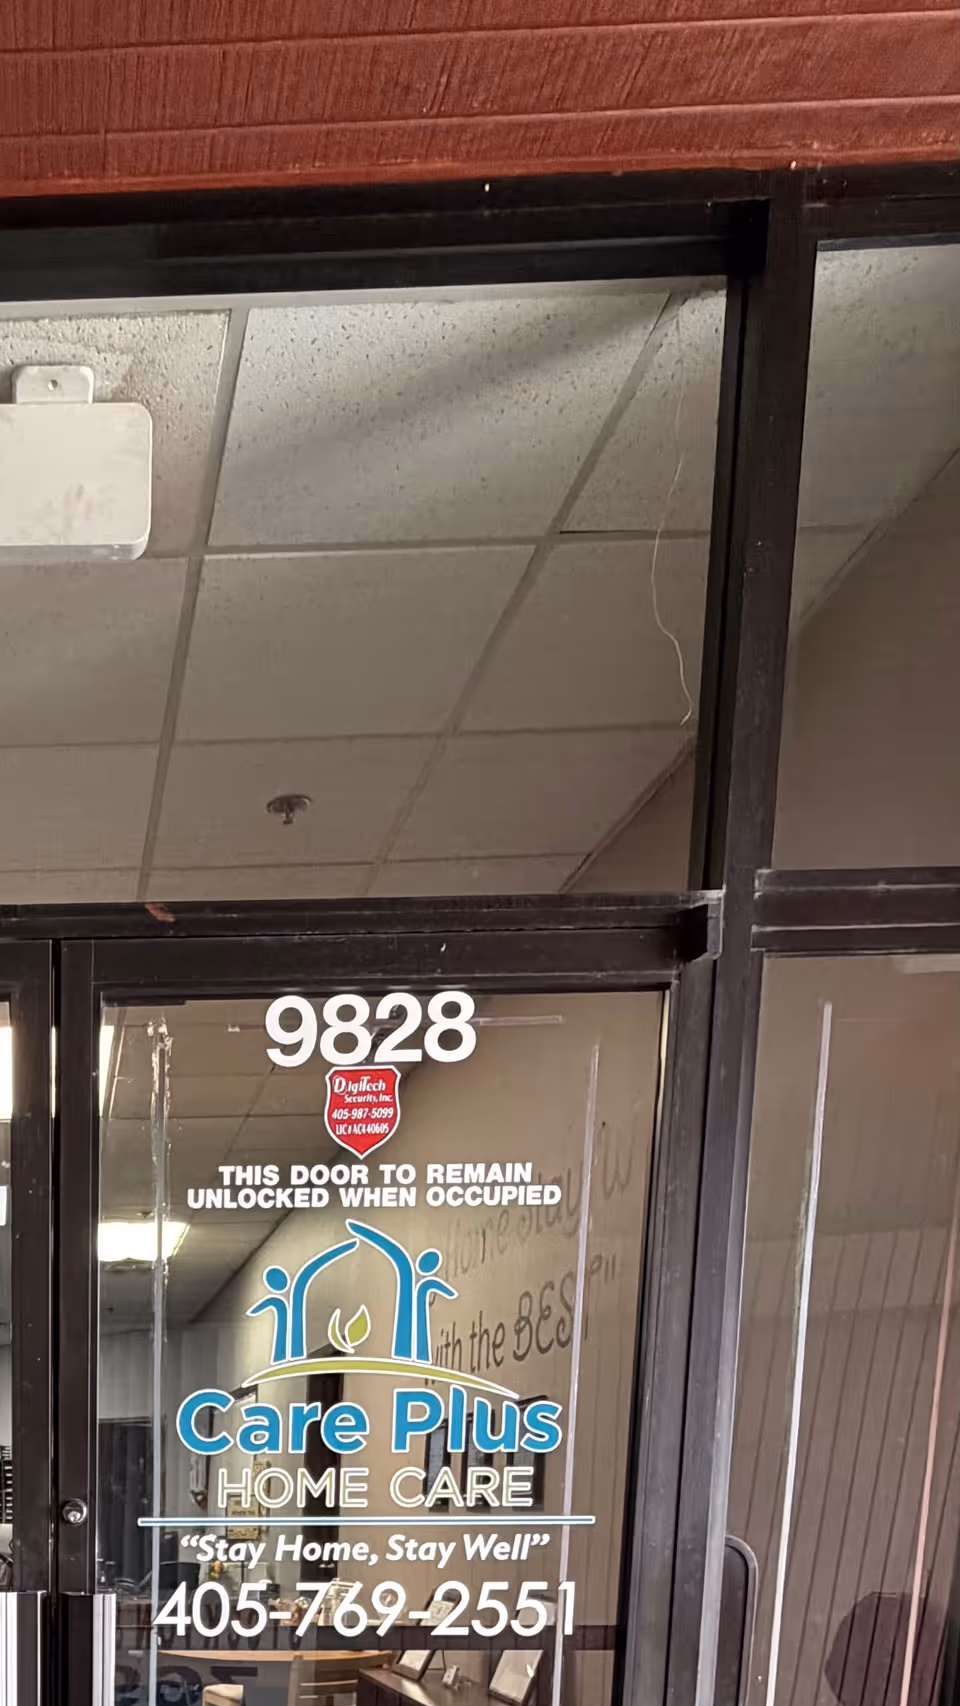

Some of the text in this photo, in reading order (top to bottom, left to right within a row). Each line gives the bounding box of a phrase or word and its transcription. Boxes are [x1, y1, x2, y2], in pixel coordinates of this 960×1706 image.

[265, 991, 477, 1067] 9828
[331, 1107, 394, 1120] 405-987-5099
[218, 1162, 532, 1186] THIS DOOR TO REMAIN
[187, 1185, 562, 1208] UNLOCKED WHEN OCCUPIED
[470, 1310, 506, 1372] the
[176, 1385, 563, 1456] Care Plus
[217, 1466, 535, 1509] HOME CARE
[180, 1533, 551, 1569] “Stay Home, Stay Well”
[153, 1581, 576, 1638] 405-769-2551
